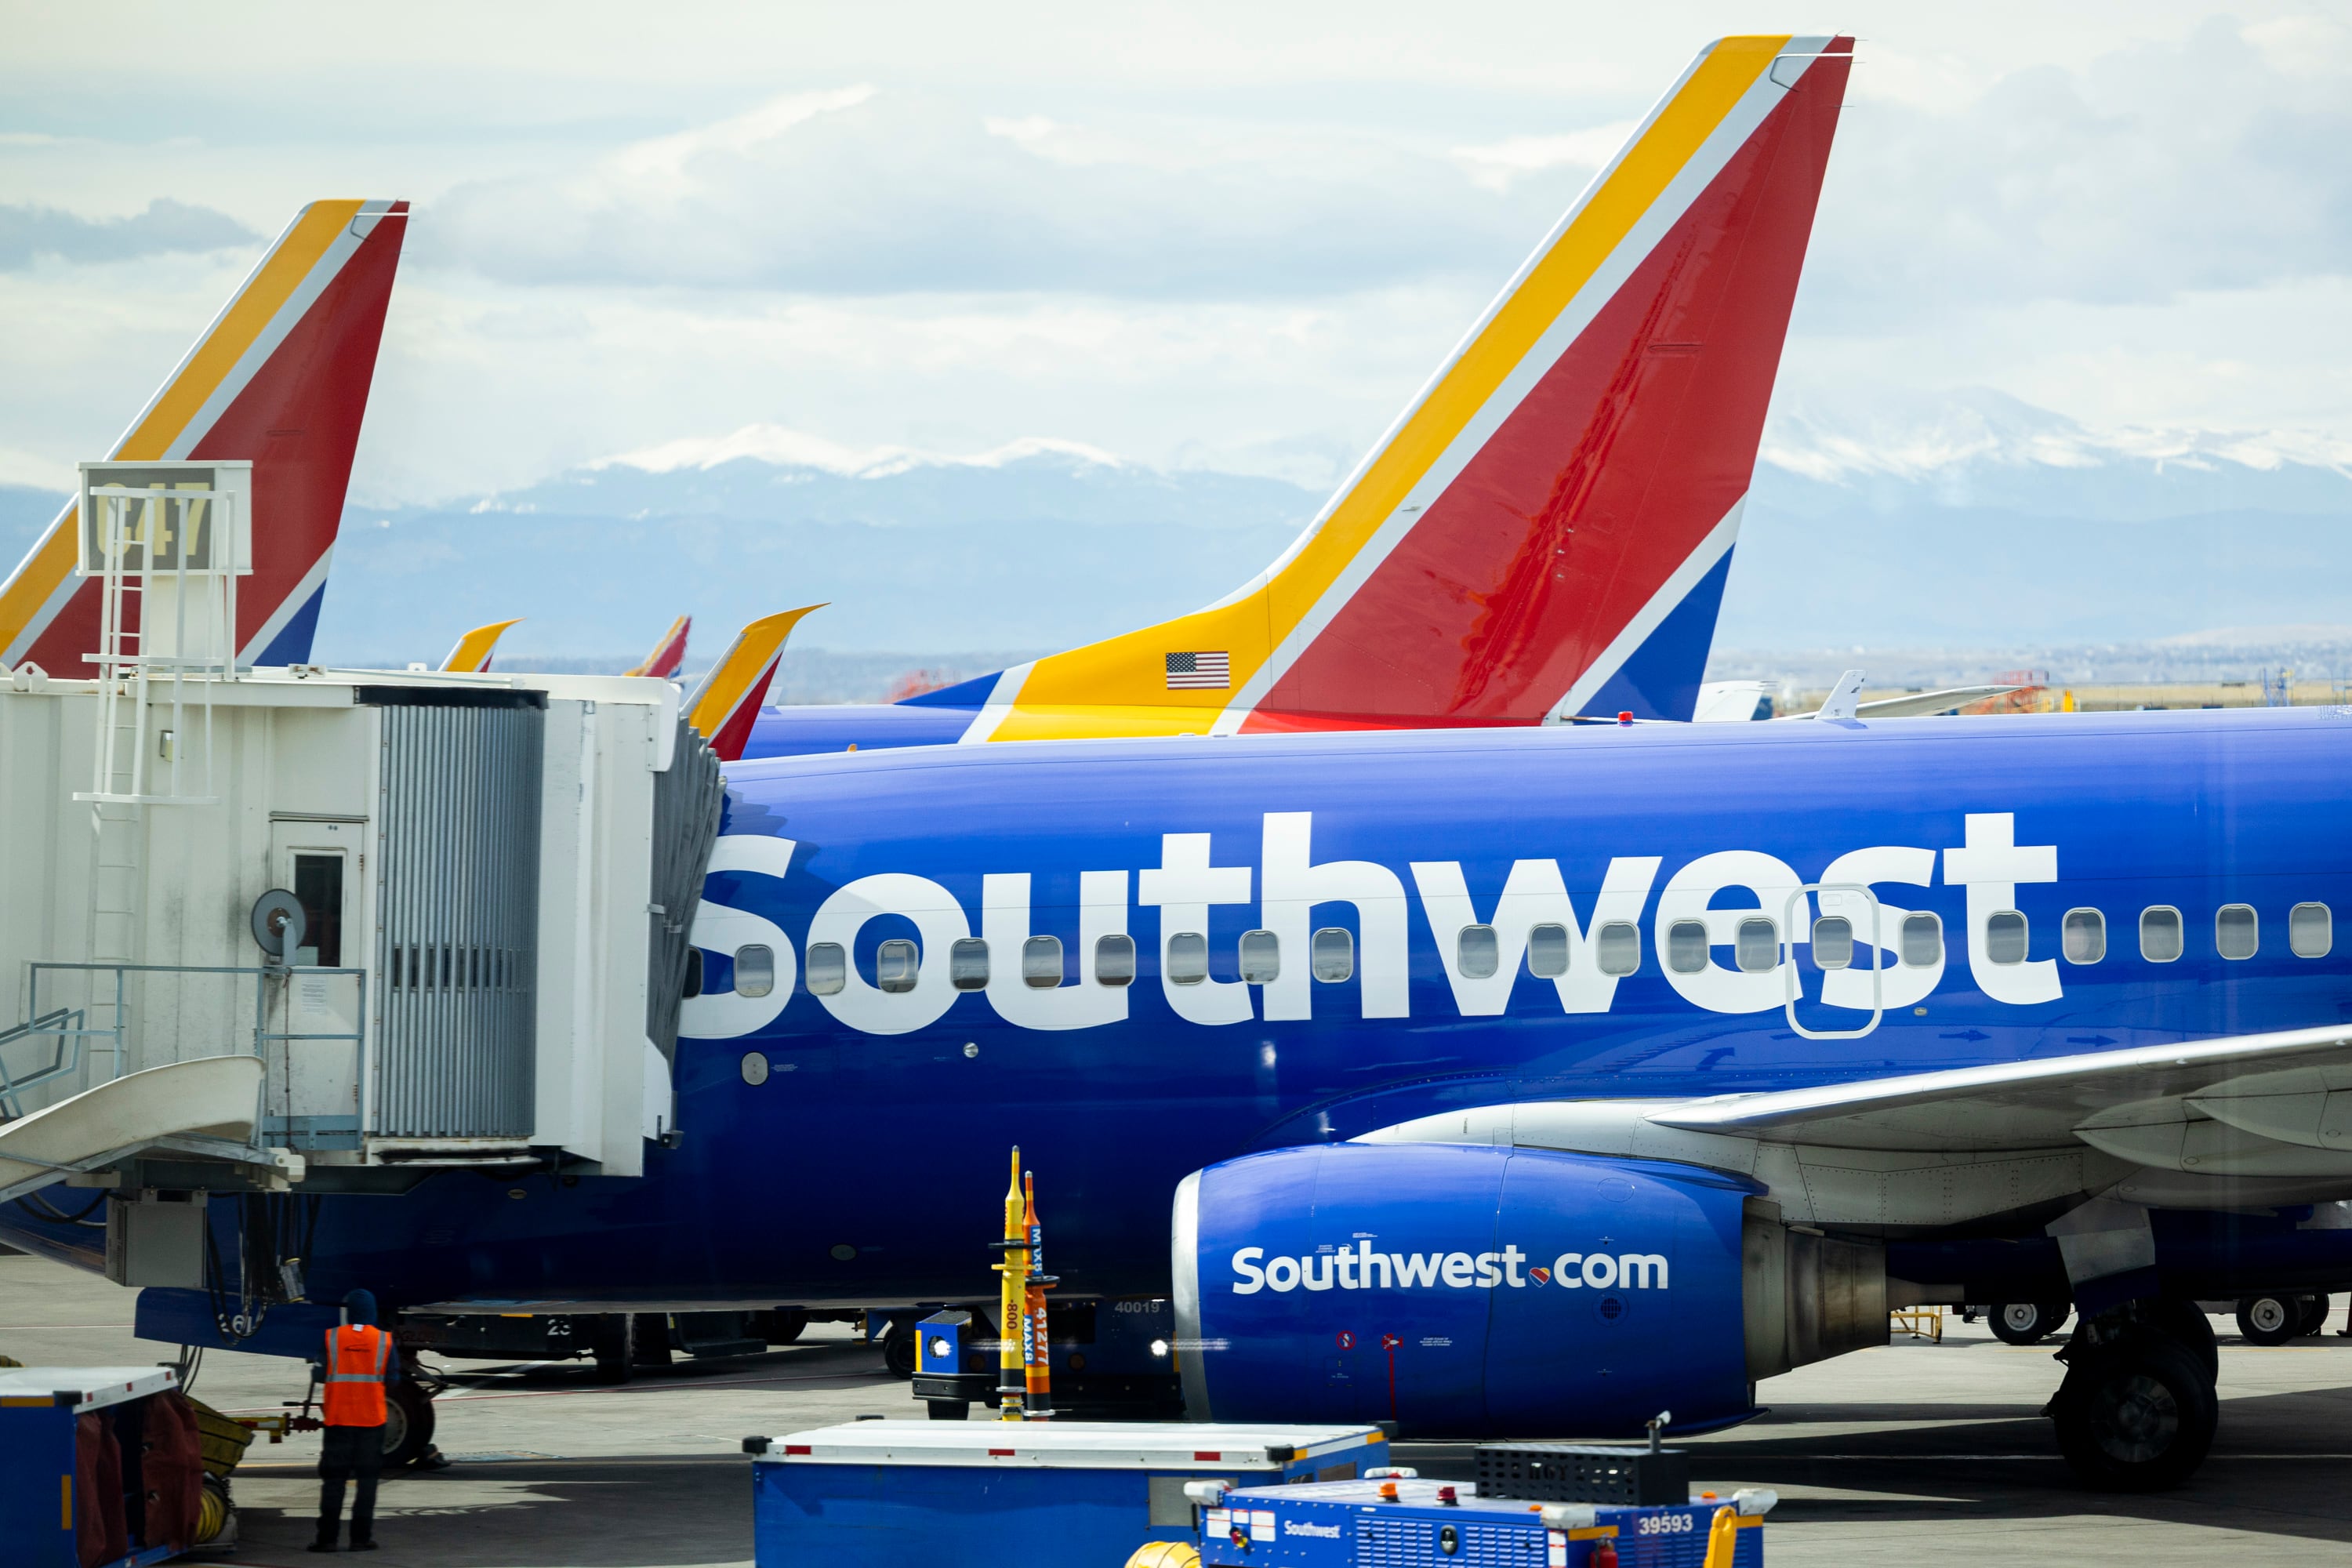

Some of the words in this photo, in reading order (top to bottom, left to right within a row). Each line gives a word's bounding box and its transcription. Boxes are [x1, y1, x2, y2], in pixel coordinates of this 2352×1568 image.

[677, 811, 2063, 1040] Southwest
[1115, 1301, 1160, 1313] 40019
[1024, 1318, 1033, 1362] MAX8
[1036, 1307, 1049, 1365] 41277
[1284, 1519, 1341, 1539] Southwest
[1639, 1514, 1693, 1534] 39593
